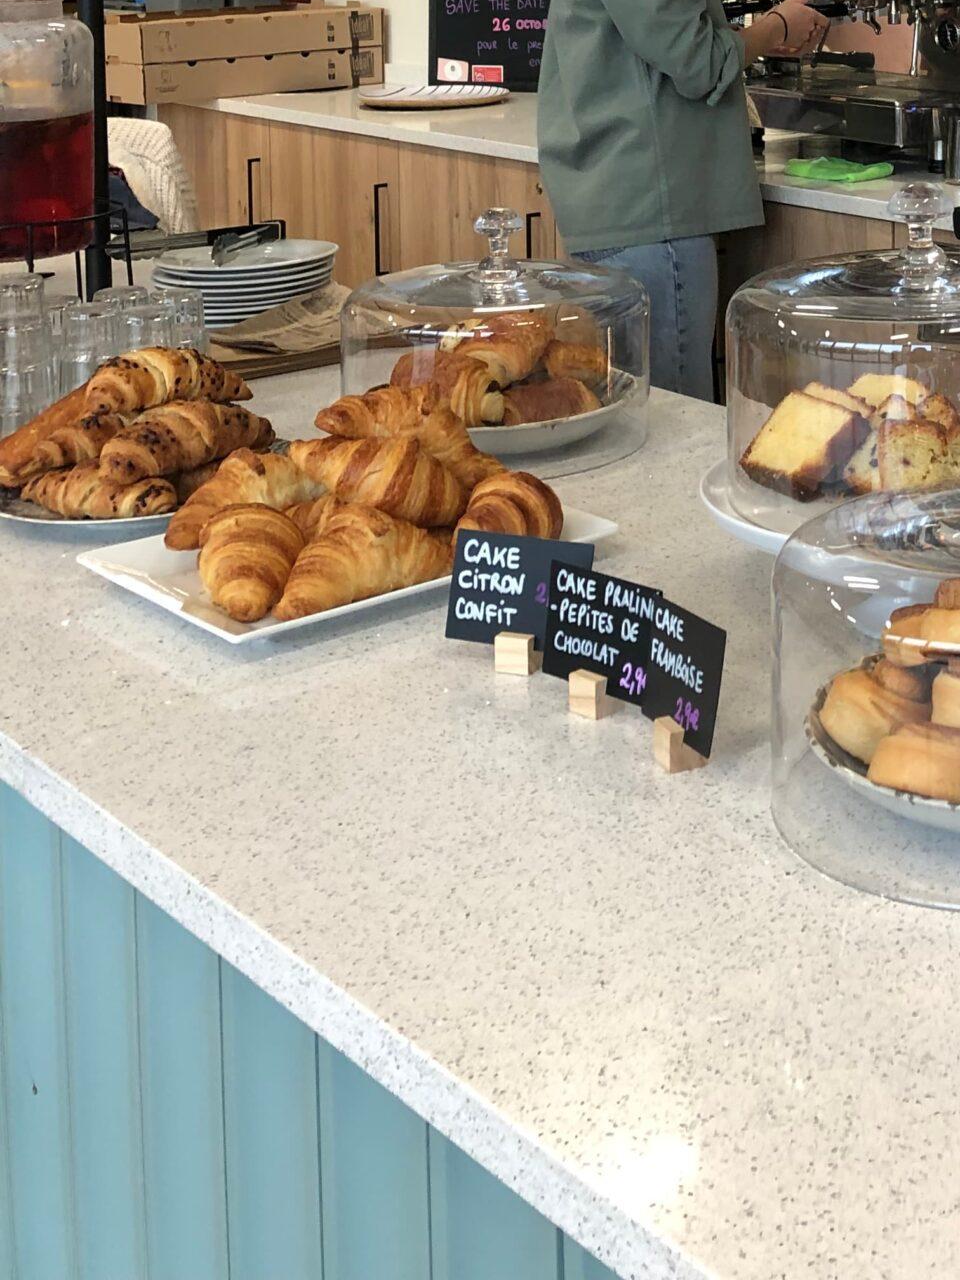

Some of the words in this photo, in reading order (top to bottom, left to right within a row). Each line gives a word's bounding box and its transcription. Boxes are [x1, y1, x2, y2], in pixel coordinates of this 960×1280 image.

[492, 17, 511, 32] 26
[515, 19, 549, 31] OCTOB
[477, 40, 498, 56] pour
[508, 37, 519, 50] le
[463, 539, 521, 570] CAKE
[556, 569, 597, 600] CAKE
[620, 618, 640, 642] DE
[655, 608, 685, 642] CAKE
